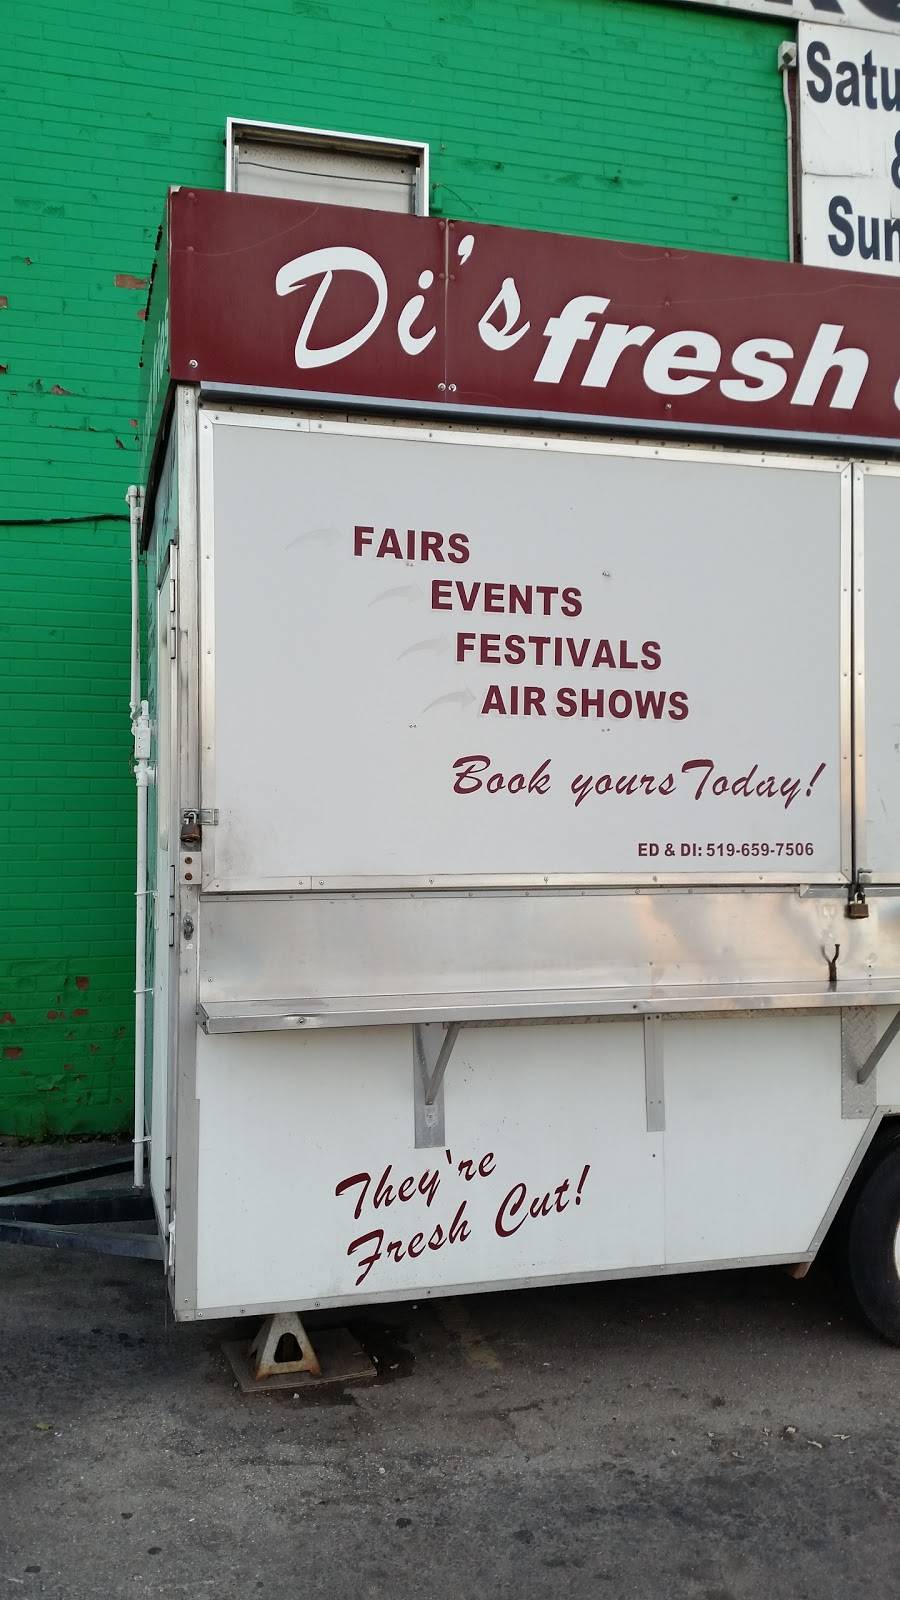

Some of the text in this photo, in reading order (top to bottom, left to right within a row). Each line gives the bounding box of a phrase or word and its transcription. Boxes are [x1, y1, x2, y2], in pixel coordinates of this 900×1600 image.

[275, 234, 869, 410] Di's fresh
[353, 526, 470, 564] FAIRS
[431, 579, 583, 617] EVENTS
[456, 632, 662, 671] FESTIVALS
[481, 685, 689, 721] AIR SHOWS
[452, 755, 827, 809] Book yours Today!
[638, 843, 814, 857] ED & DI: 519-659-7506
[335, 1149, 496, 1220] They're
[347, 1164, 591, 1286] Fresh Cut!
